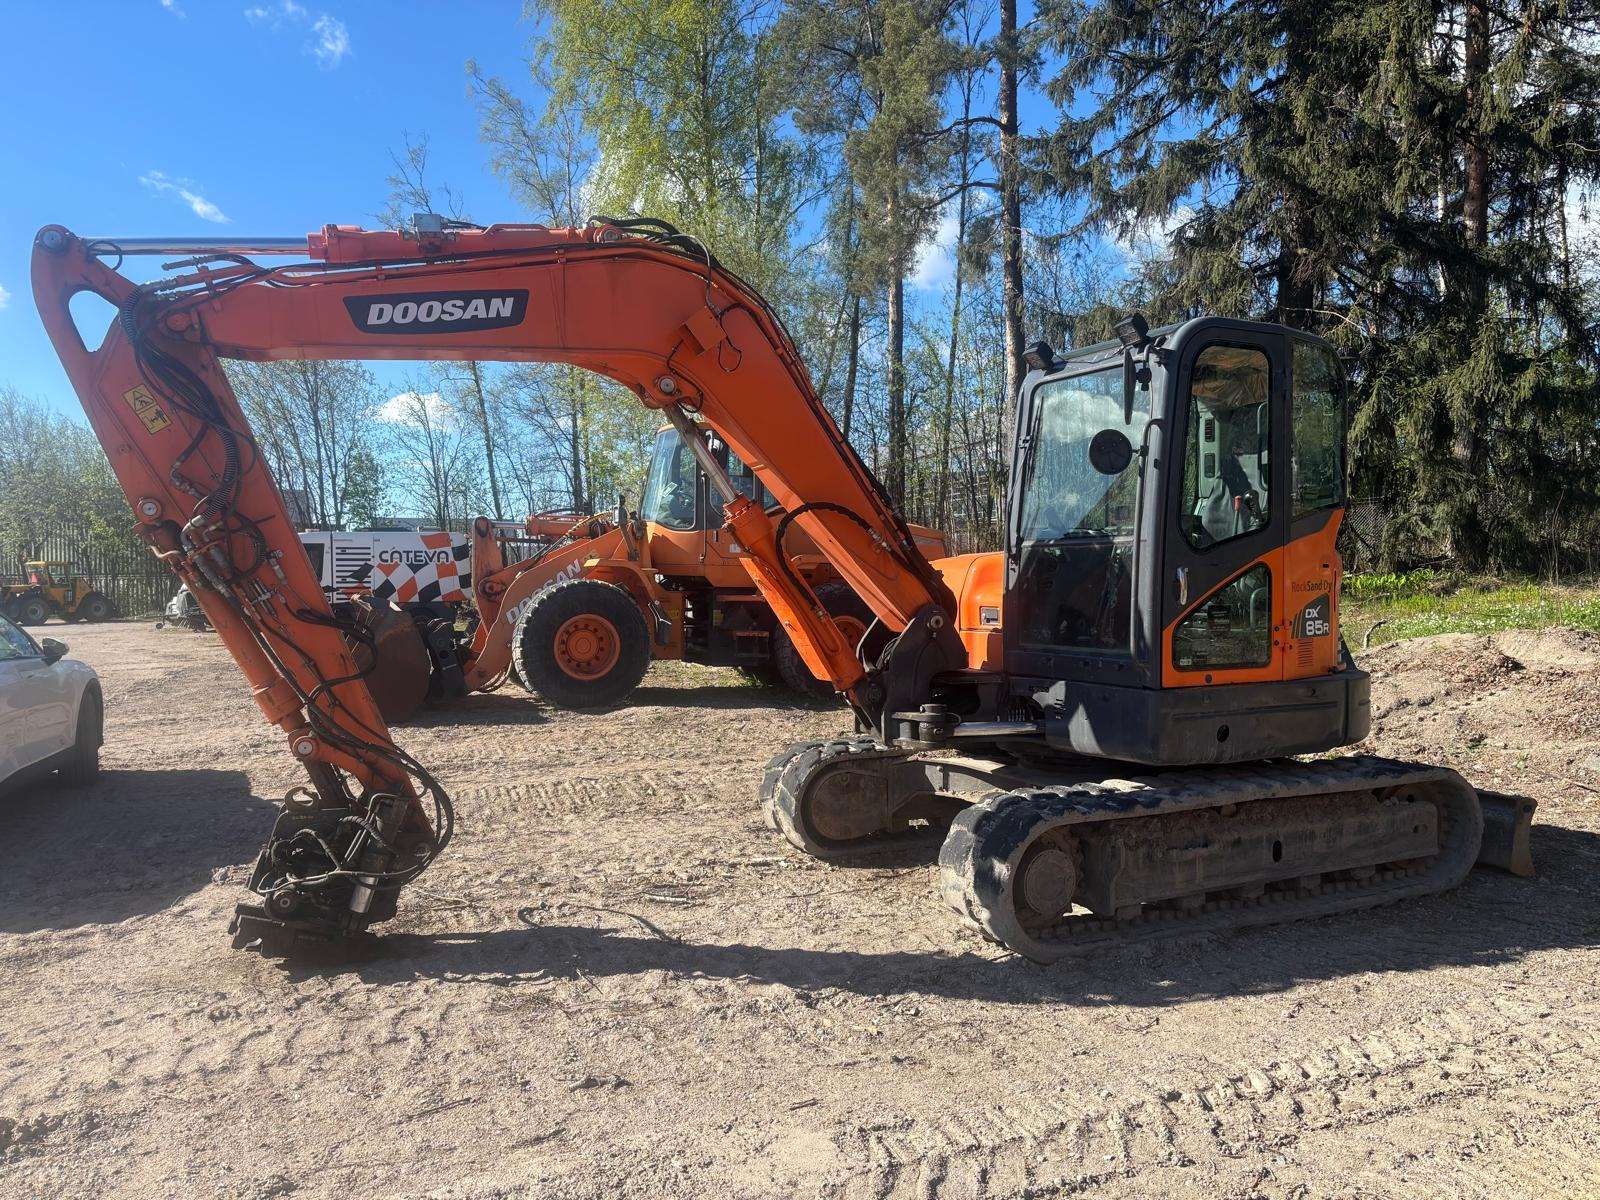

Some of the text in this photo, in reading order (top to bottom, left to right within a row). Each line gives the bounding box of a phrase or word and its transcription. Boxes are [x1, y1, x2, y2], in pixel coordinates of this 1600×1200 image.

[366, 297, 514, 325] DOOSAN
[506, 559, 582, 625] DOAN
[1305, 605, 1321, 618] DX
[1305, 620, 1330, 636] 85R
